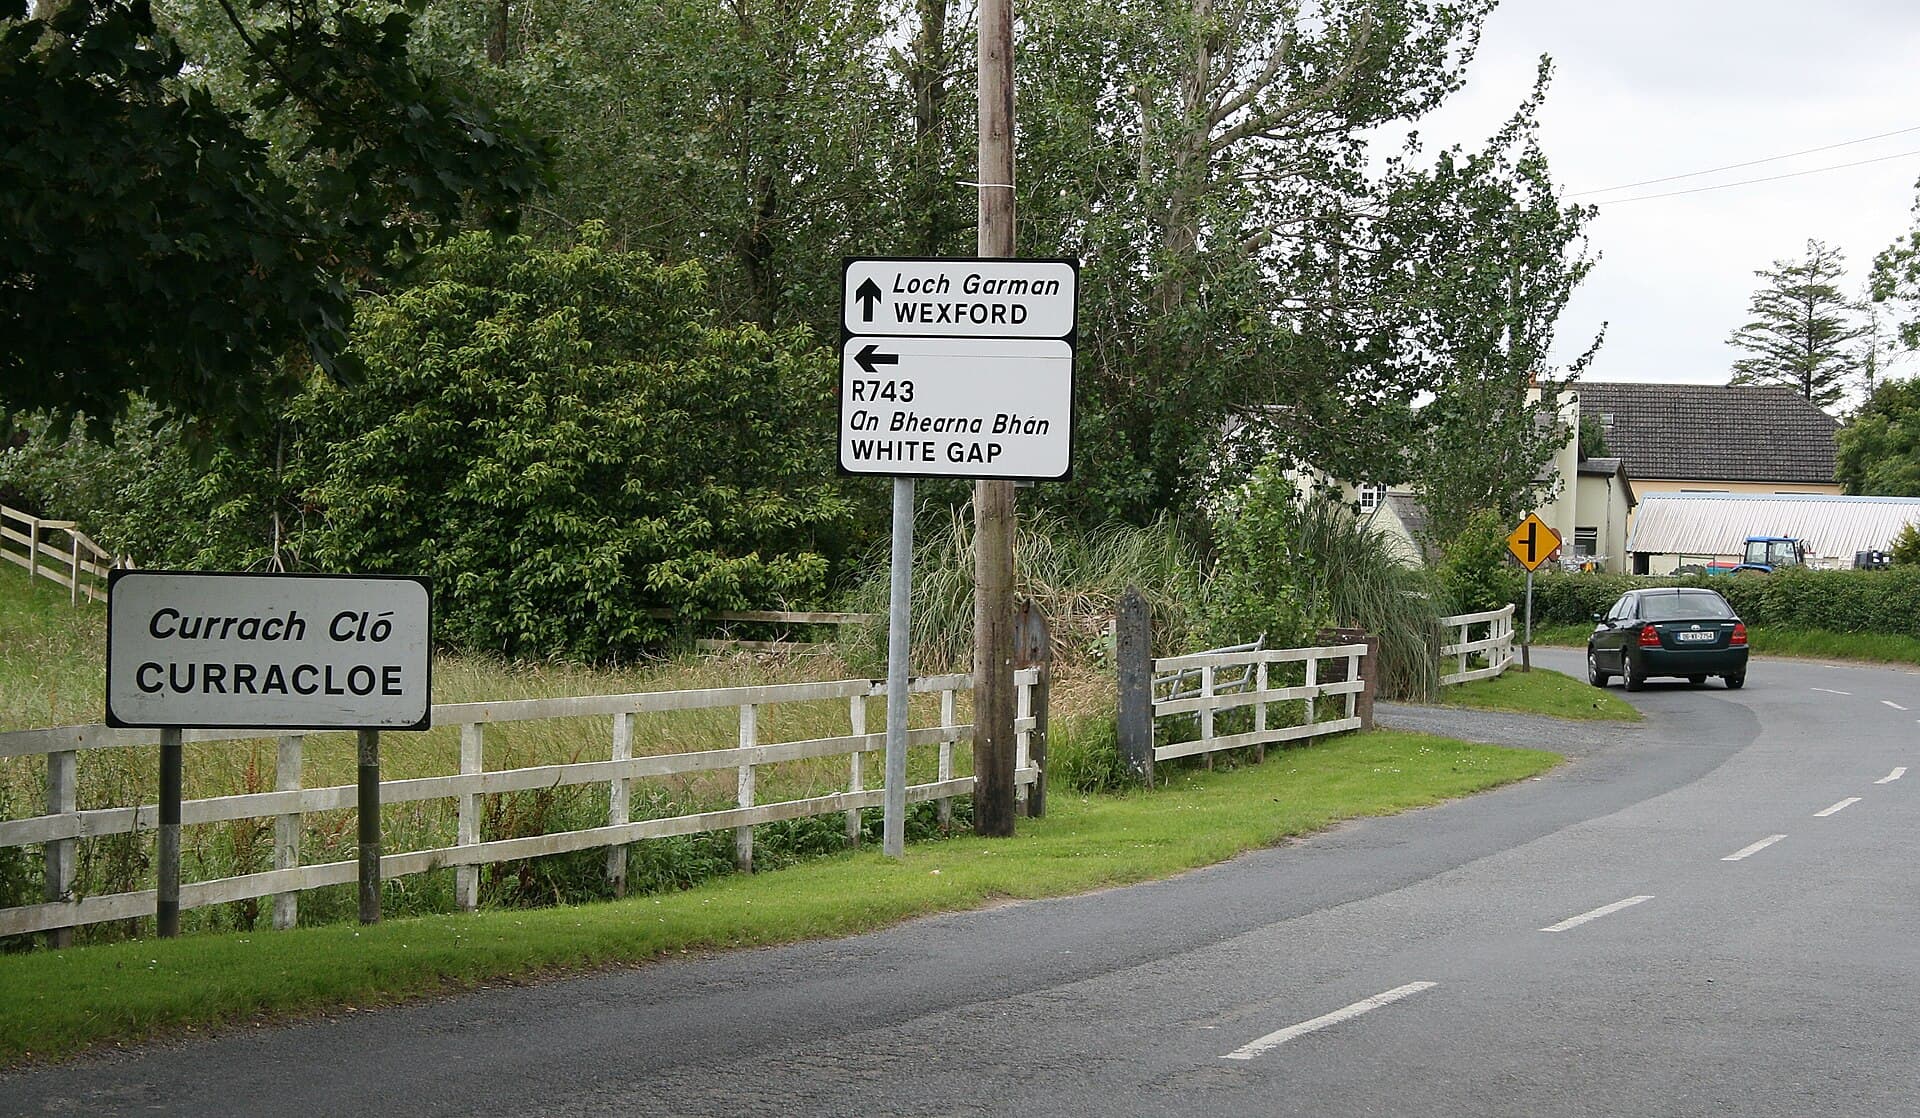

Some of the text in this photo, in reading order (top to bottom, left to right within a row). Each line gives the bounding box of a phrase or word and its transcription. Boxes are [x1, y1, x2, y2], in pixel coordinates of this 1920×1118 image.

[893, 272, 1060, 296] Loch Garman
[894, 302, 1028, 325] WEXFORD
[852, 380, 914, 403] R743
[850, 410, 1050, 436] An Bhearna Bhán
[851, 439, 1002, 464] WHITE GAP
[149, 607, 394, 643] Currach Cló
[135, 661, 403, 697] CURRACLOE
